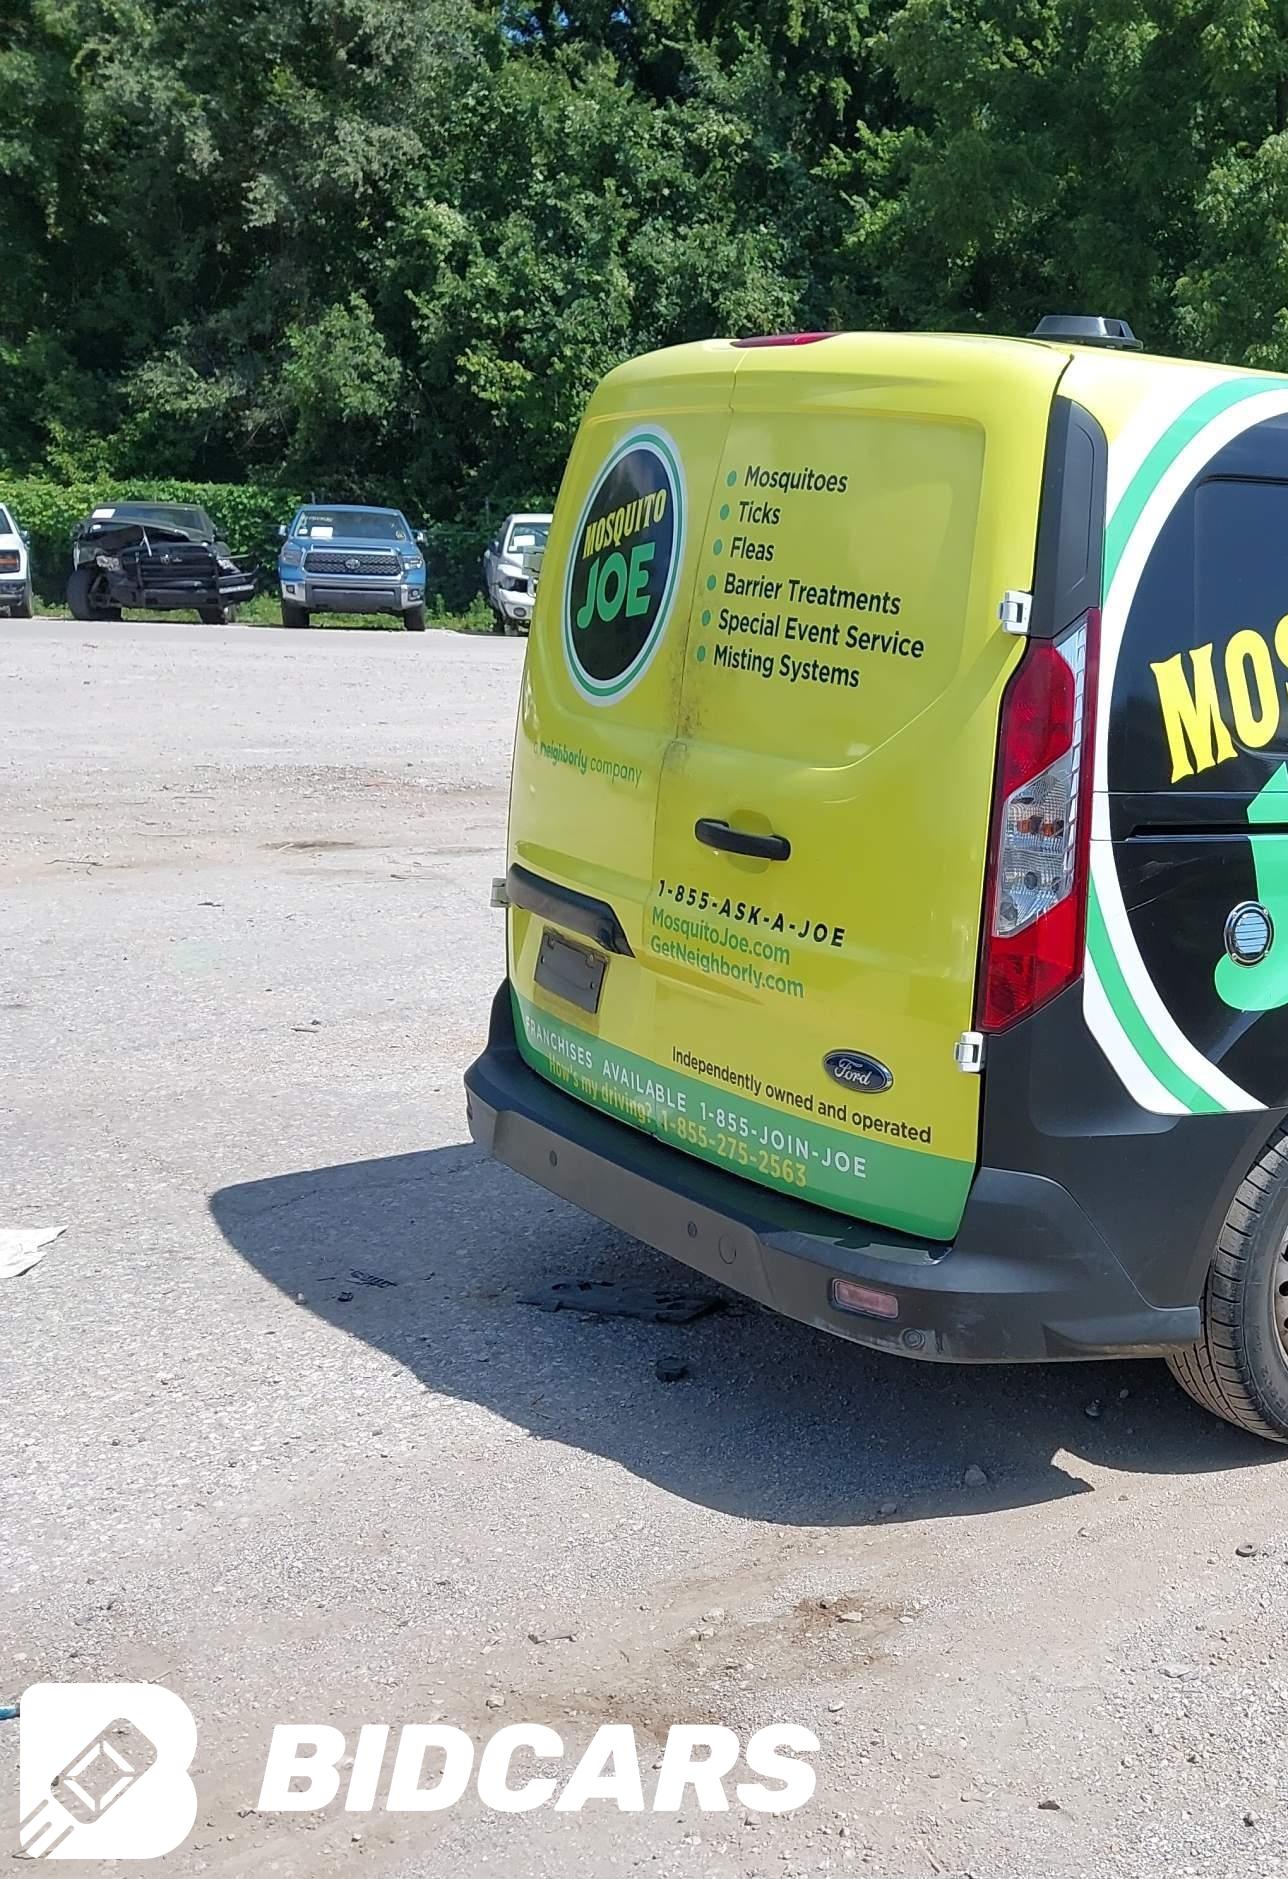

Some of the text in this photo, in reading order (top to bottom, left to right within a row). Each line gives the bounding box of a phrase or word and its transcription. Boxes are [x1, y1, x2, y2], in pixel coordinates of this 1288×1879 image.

[744, 465, 848, 493] Mosquitoes
[582, 488, 667, 559] MOSQUITO
[738, 500, 781, 525] Ticks
[730, 536, 775, 561] Fleas
[576, 541, 656, 629] JOE
[724, 572, 901, 615] Barrier Treatments
[718, 608, 924, 658] Special Event Service
[713, 644, 860, 687] Misting Systems
[540, 739, 588, 775] neighborly
[590, 757, 642, 789] company
[652, 906, 790, 965] MosquitoJoe.com
[658, 879, 845, 947] 1-855-ASK-A-JOE
[650, 934, 804, 998] GetNeighborly.com
[525, 1015, 867, 1178] FRANCHISES AVAILABLE 1-855-JOIN-JOE
[672, 1046, 932, 1145] Independently owned and operated
[834, 1057, 872, 1086] Ford
[581, 1076, 598, 1101] my
[601, 1081, 652, 1124] driving?
[661, 1110, 807, 1188] 1-855-275-2563
